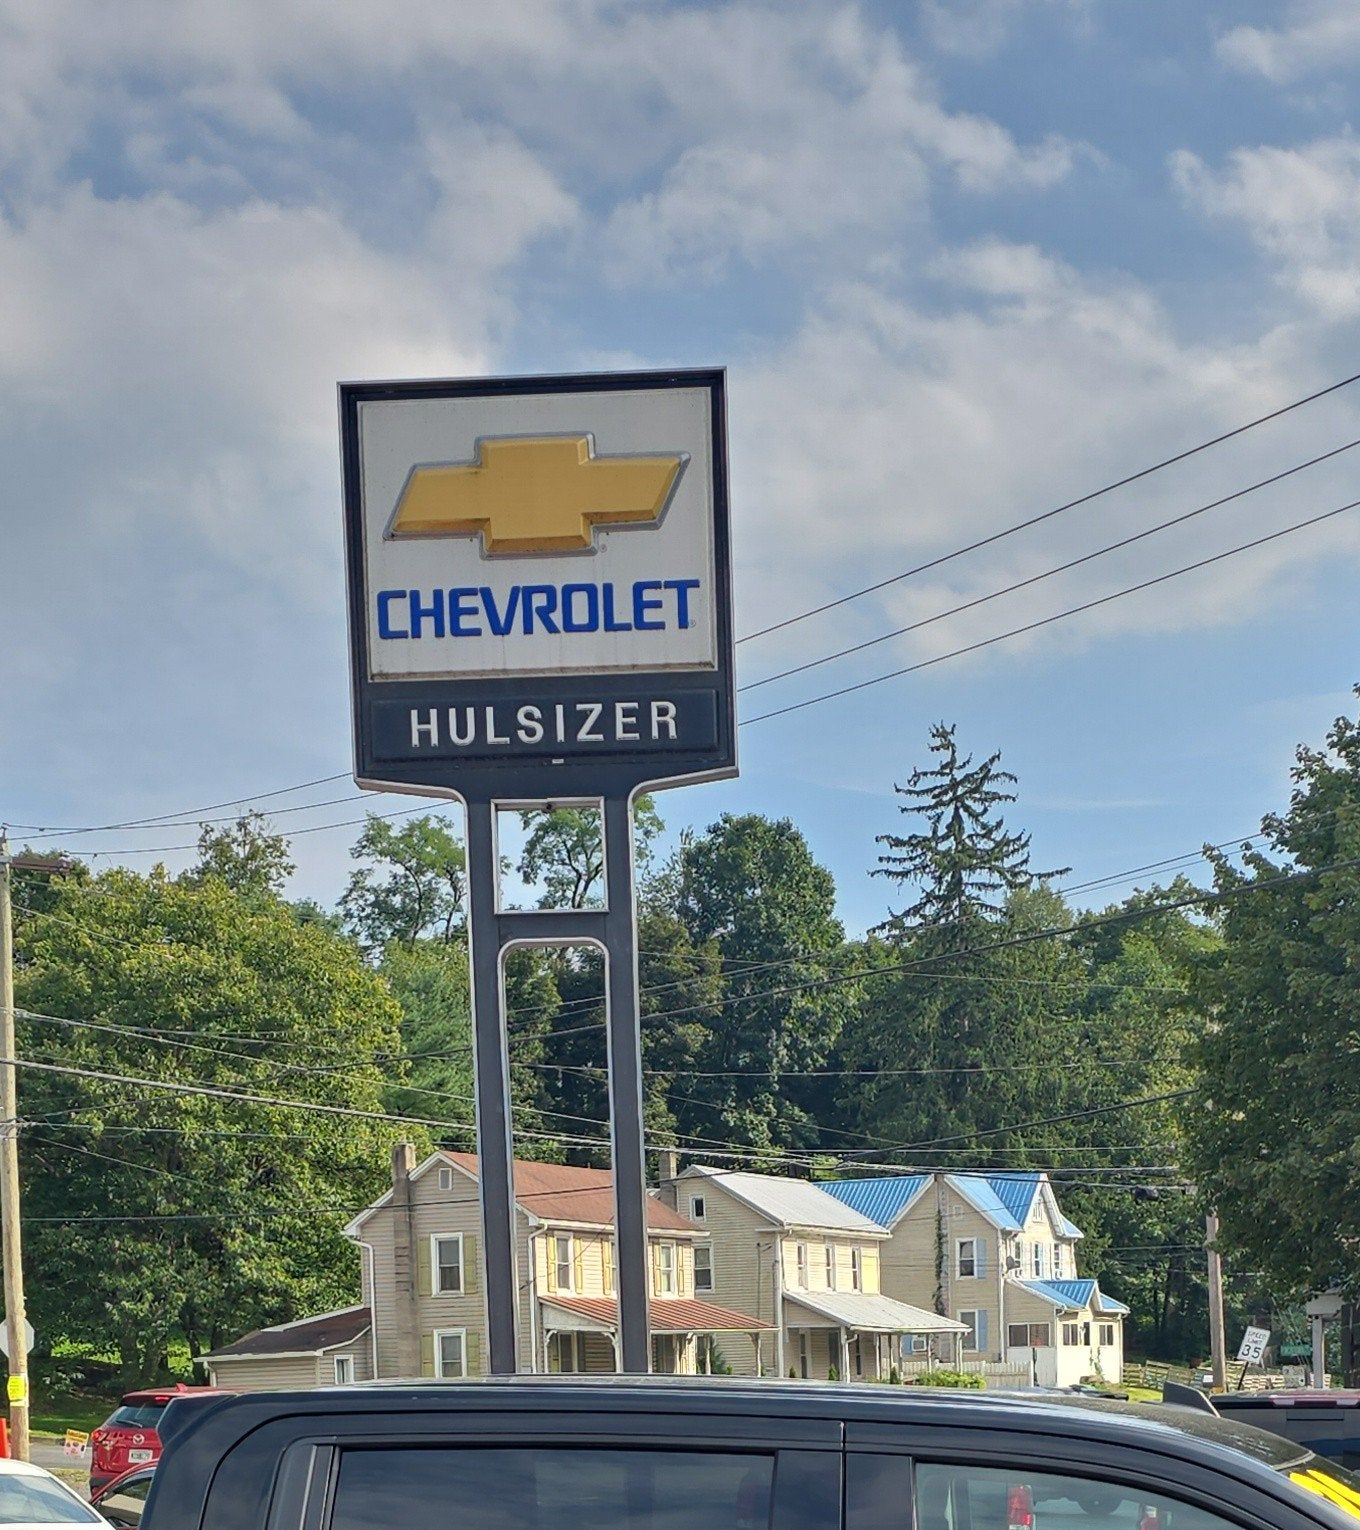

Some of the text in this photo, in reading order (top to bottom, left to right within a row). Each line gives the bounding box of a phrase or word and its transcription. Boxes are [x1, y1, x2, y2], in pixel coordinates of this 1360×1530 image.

[377, 579, 700, 640] CHEVROLET
[409, 701, 678, 748] HULSIZER
[1241, 1344, 1262, 1359] 35
